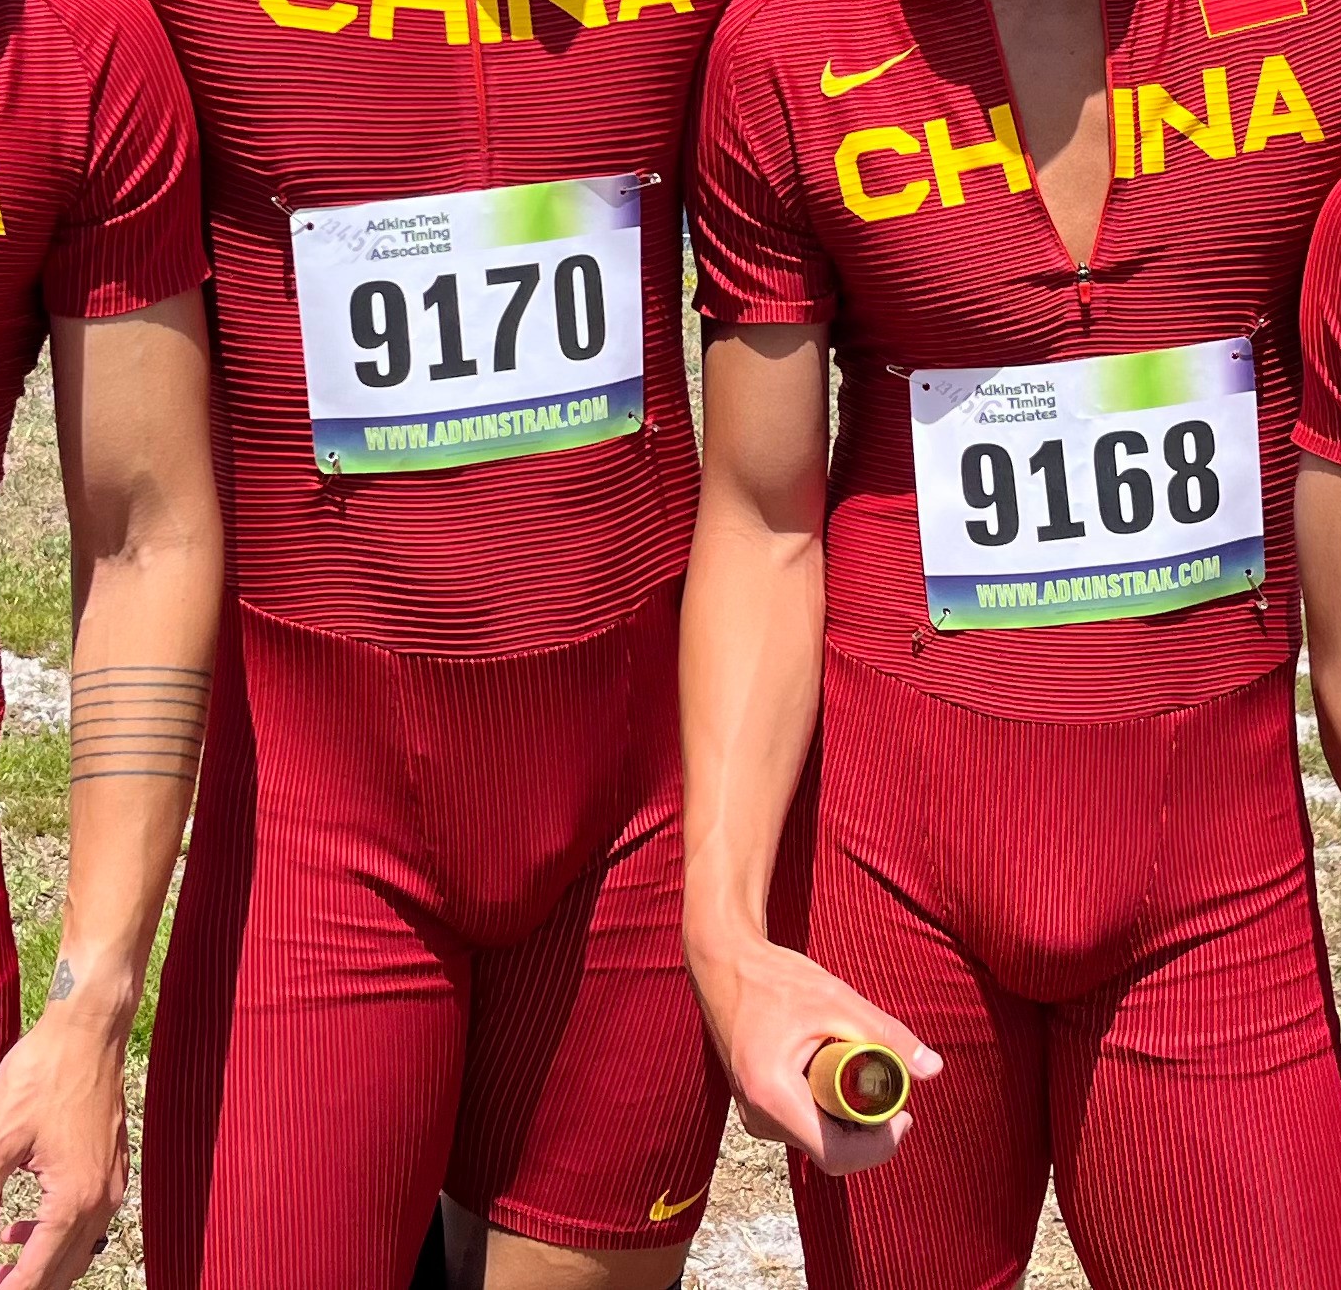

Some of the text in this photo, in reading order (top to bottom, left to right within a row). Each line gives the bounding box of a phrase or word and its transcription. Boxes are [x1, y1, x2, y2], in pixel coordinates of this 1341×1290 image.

[833, 54, 1325, 223] CHINA
[366, 212, 449, 232] AdkinsTrak
[401, 228, 451, 243] Timing
[370, 242, 452, 260] Associates
[349, 254, 606, 388] 9170
[975, 381, 1055, 397] AdkinsTrak
[1007, 396, 1056, 409] Timing
[363, 394, 609, 451] WWW.ADKINSTRAK.COM
[979, 409, 1057, 423] Associates
[960, 419, 1221, 547] 9168
[975, 555, 1222, 609] WWW.ADKINSTRAK.COM
